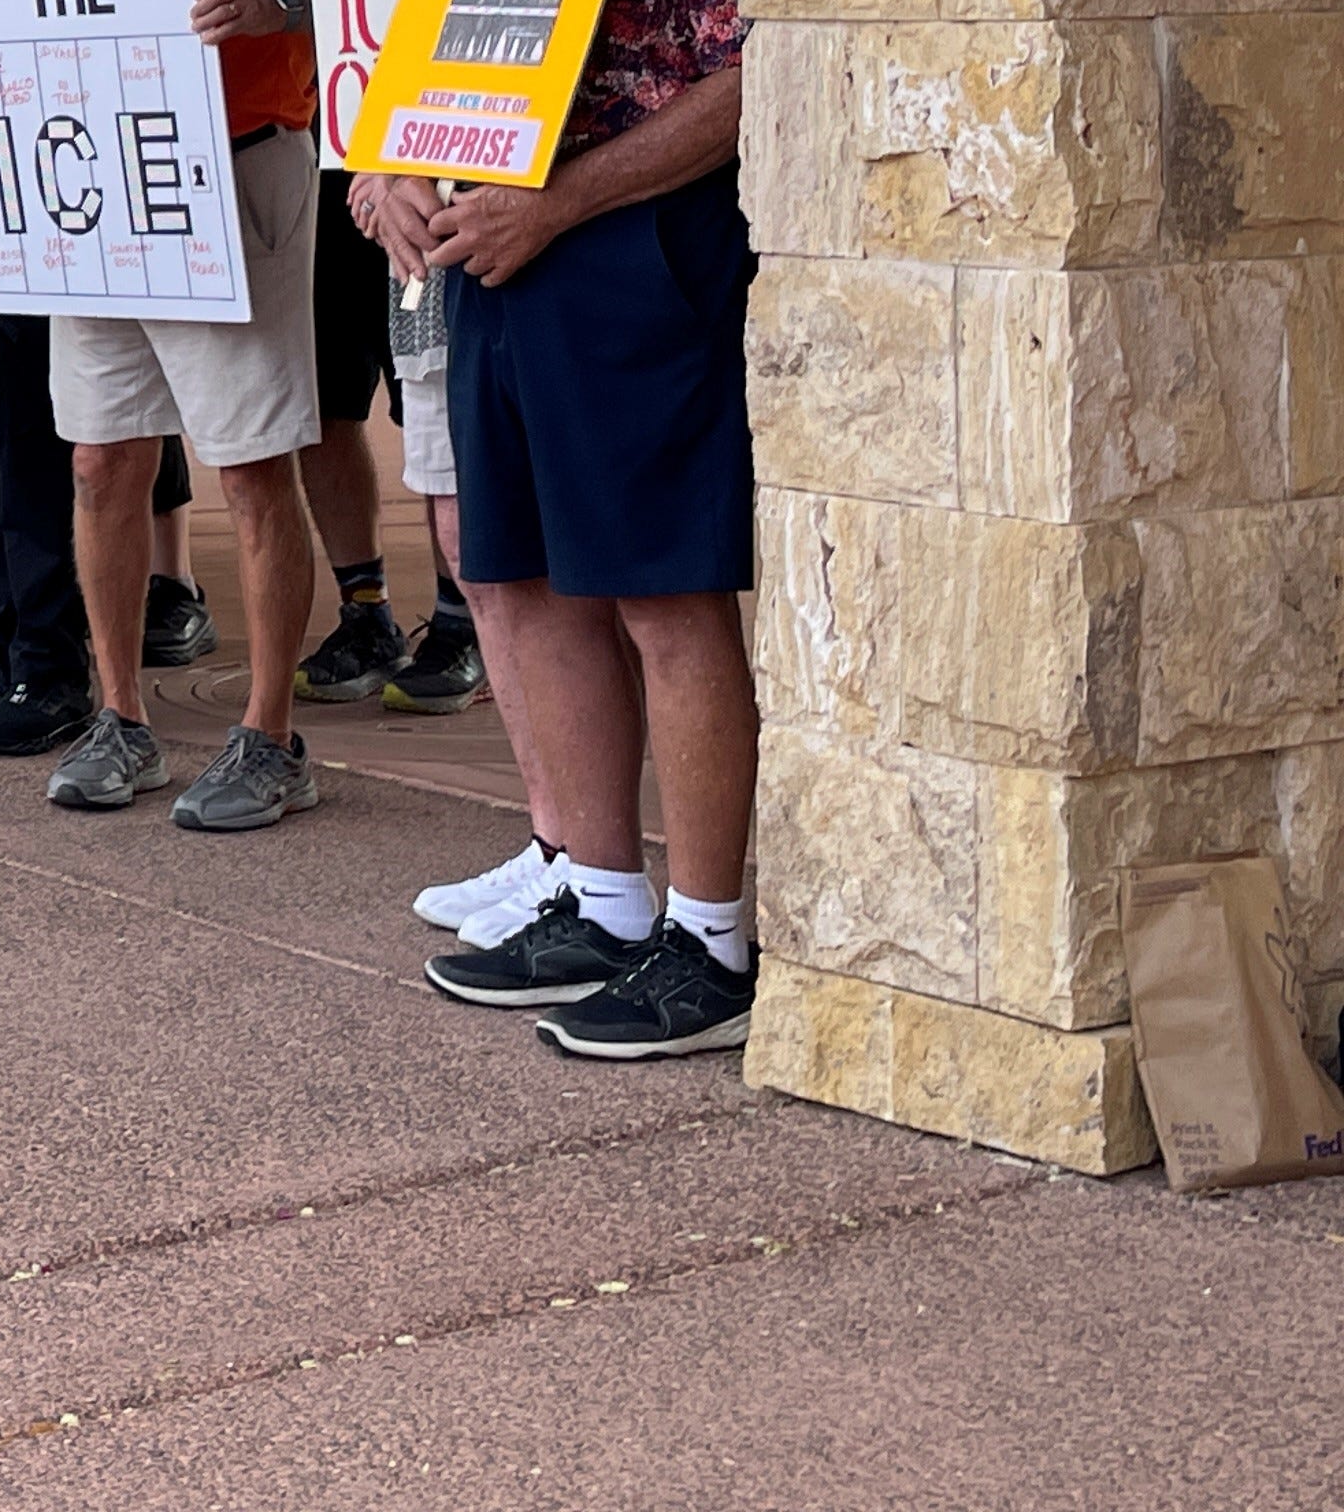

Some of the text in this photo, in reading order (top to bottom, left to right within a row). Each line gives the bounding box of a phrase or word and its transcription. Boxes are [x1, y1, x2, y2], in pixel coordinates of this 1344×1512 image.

[419, 90, 531, 114] KEEP ICE OUT OF
[397, 120, 519, 168] SURPRISE
